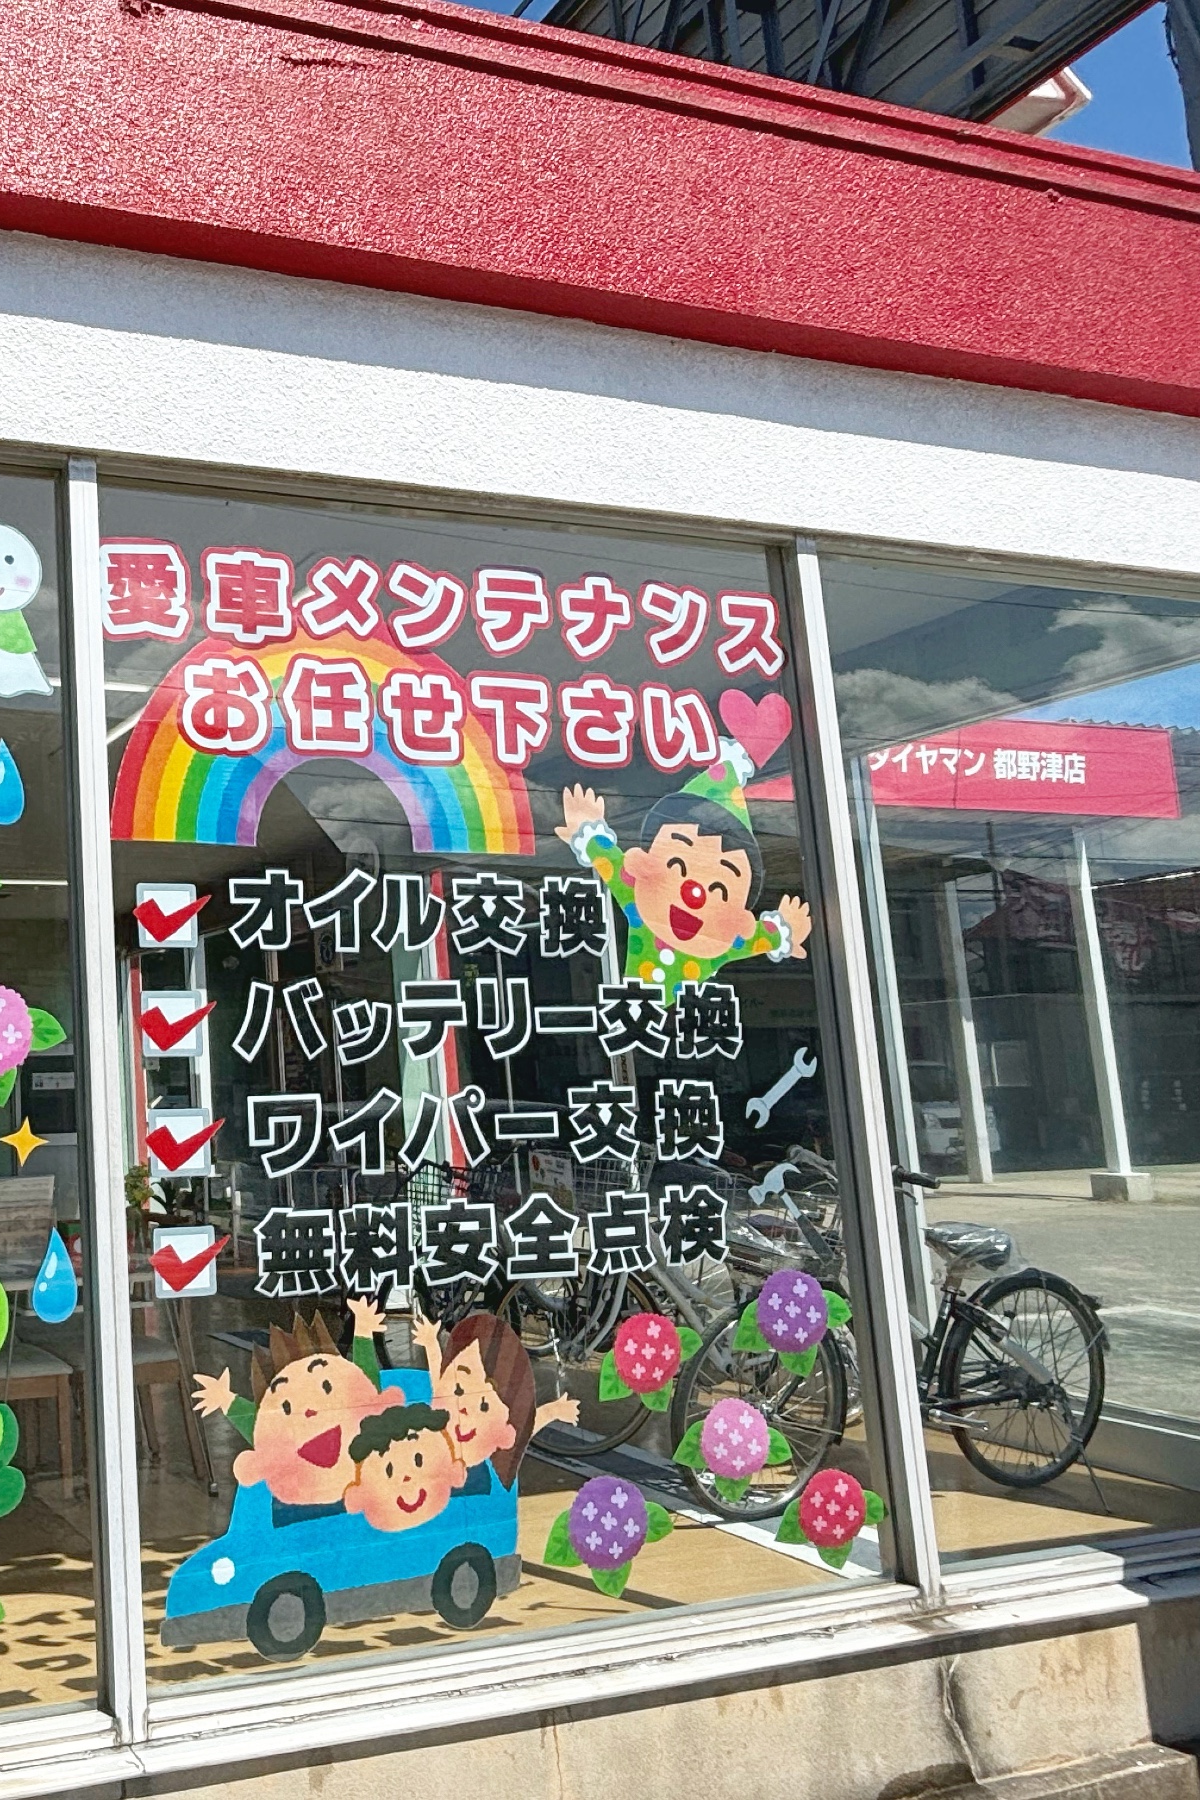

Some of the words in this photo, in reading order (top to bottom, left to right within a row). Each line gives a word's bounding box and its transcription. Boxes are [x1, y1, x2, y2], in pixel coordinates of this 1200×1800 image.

[102, 540, 785, 677] 愛車メンテナンス
[180, 656, 722, 770] お任せ下さい
[993, 748, 1086, 784] 都野津店
[228, 868, 610, 958] オイル交換
[231, 977, 743, 1065] バッテリー交換
[246, 1079, 724, 1178] ワイパー交換
[253, 1184, 730, 1297] 無料安全点検
